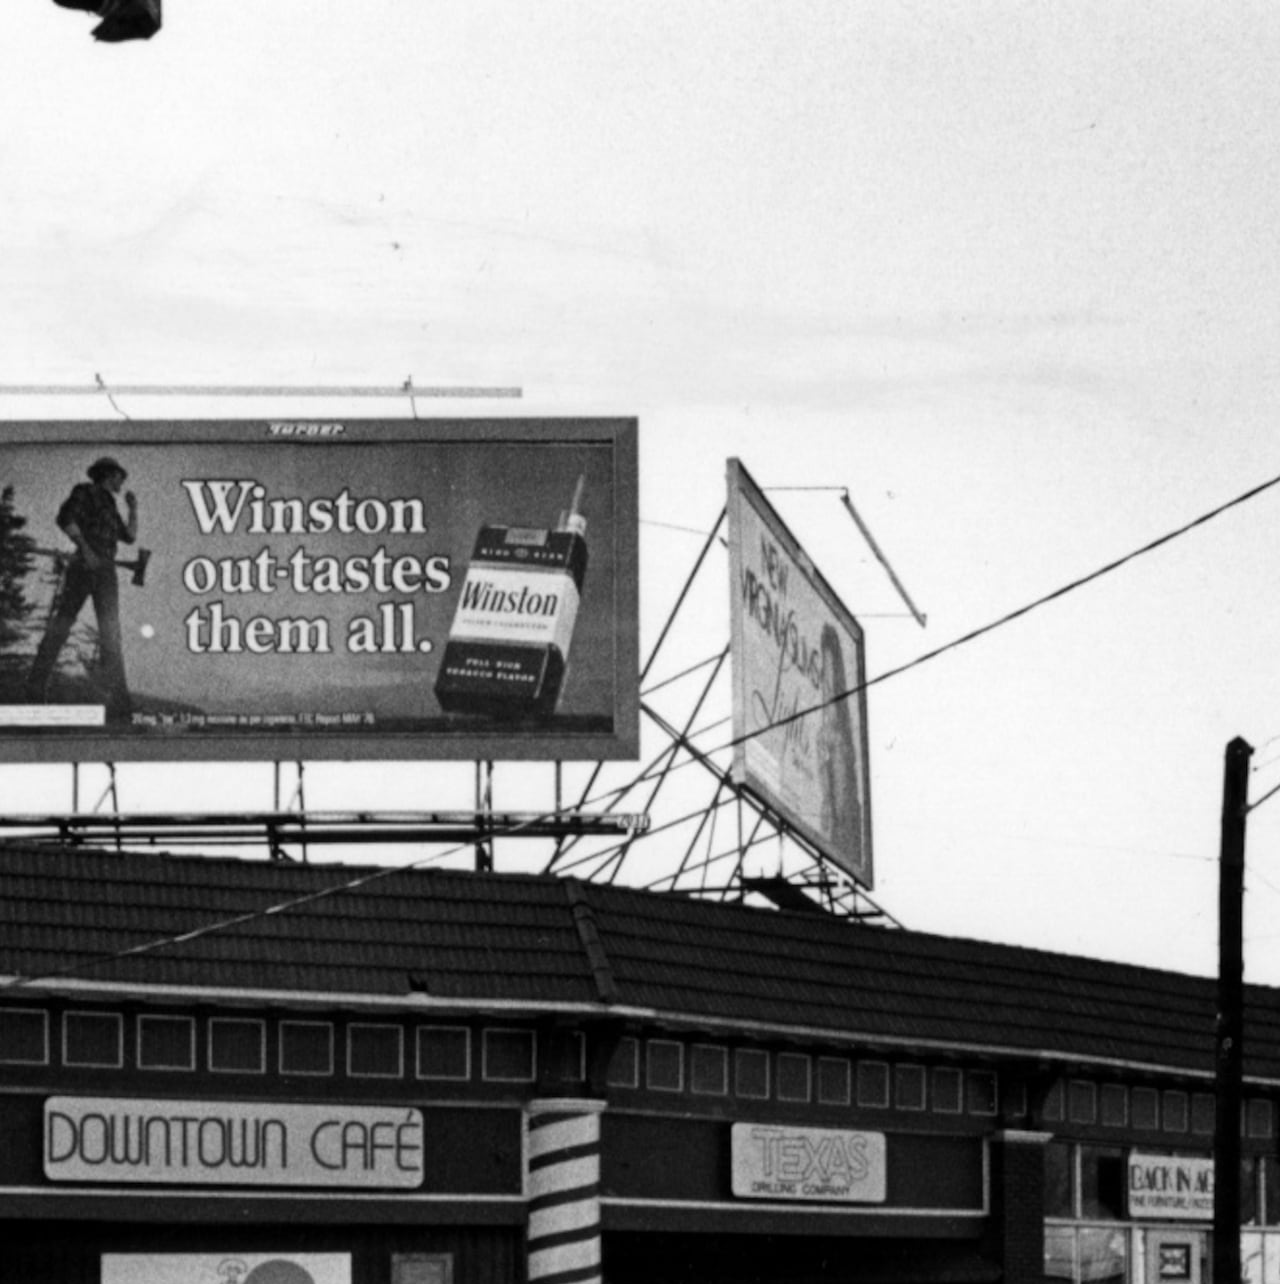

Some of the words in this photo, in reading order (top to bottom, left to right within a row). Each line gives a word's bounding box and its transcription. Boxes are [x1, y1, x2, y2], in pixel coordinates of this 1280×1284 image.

[181, 480, 427, 534] Winston
[183, 546, 451, 593] out-tastes
[461, 579, 559, 617] Winston
[185, 601, 332, 653] them
[347, 601, 433, 653] all.
[49, 1111, 288, 1169] DOWNTOWN
[310, 1109, 421, 1172] CAFÉ
[751, 1127, 870, 1184] TEXAS
